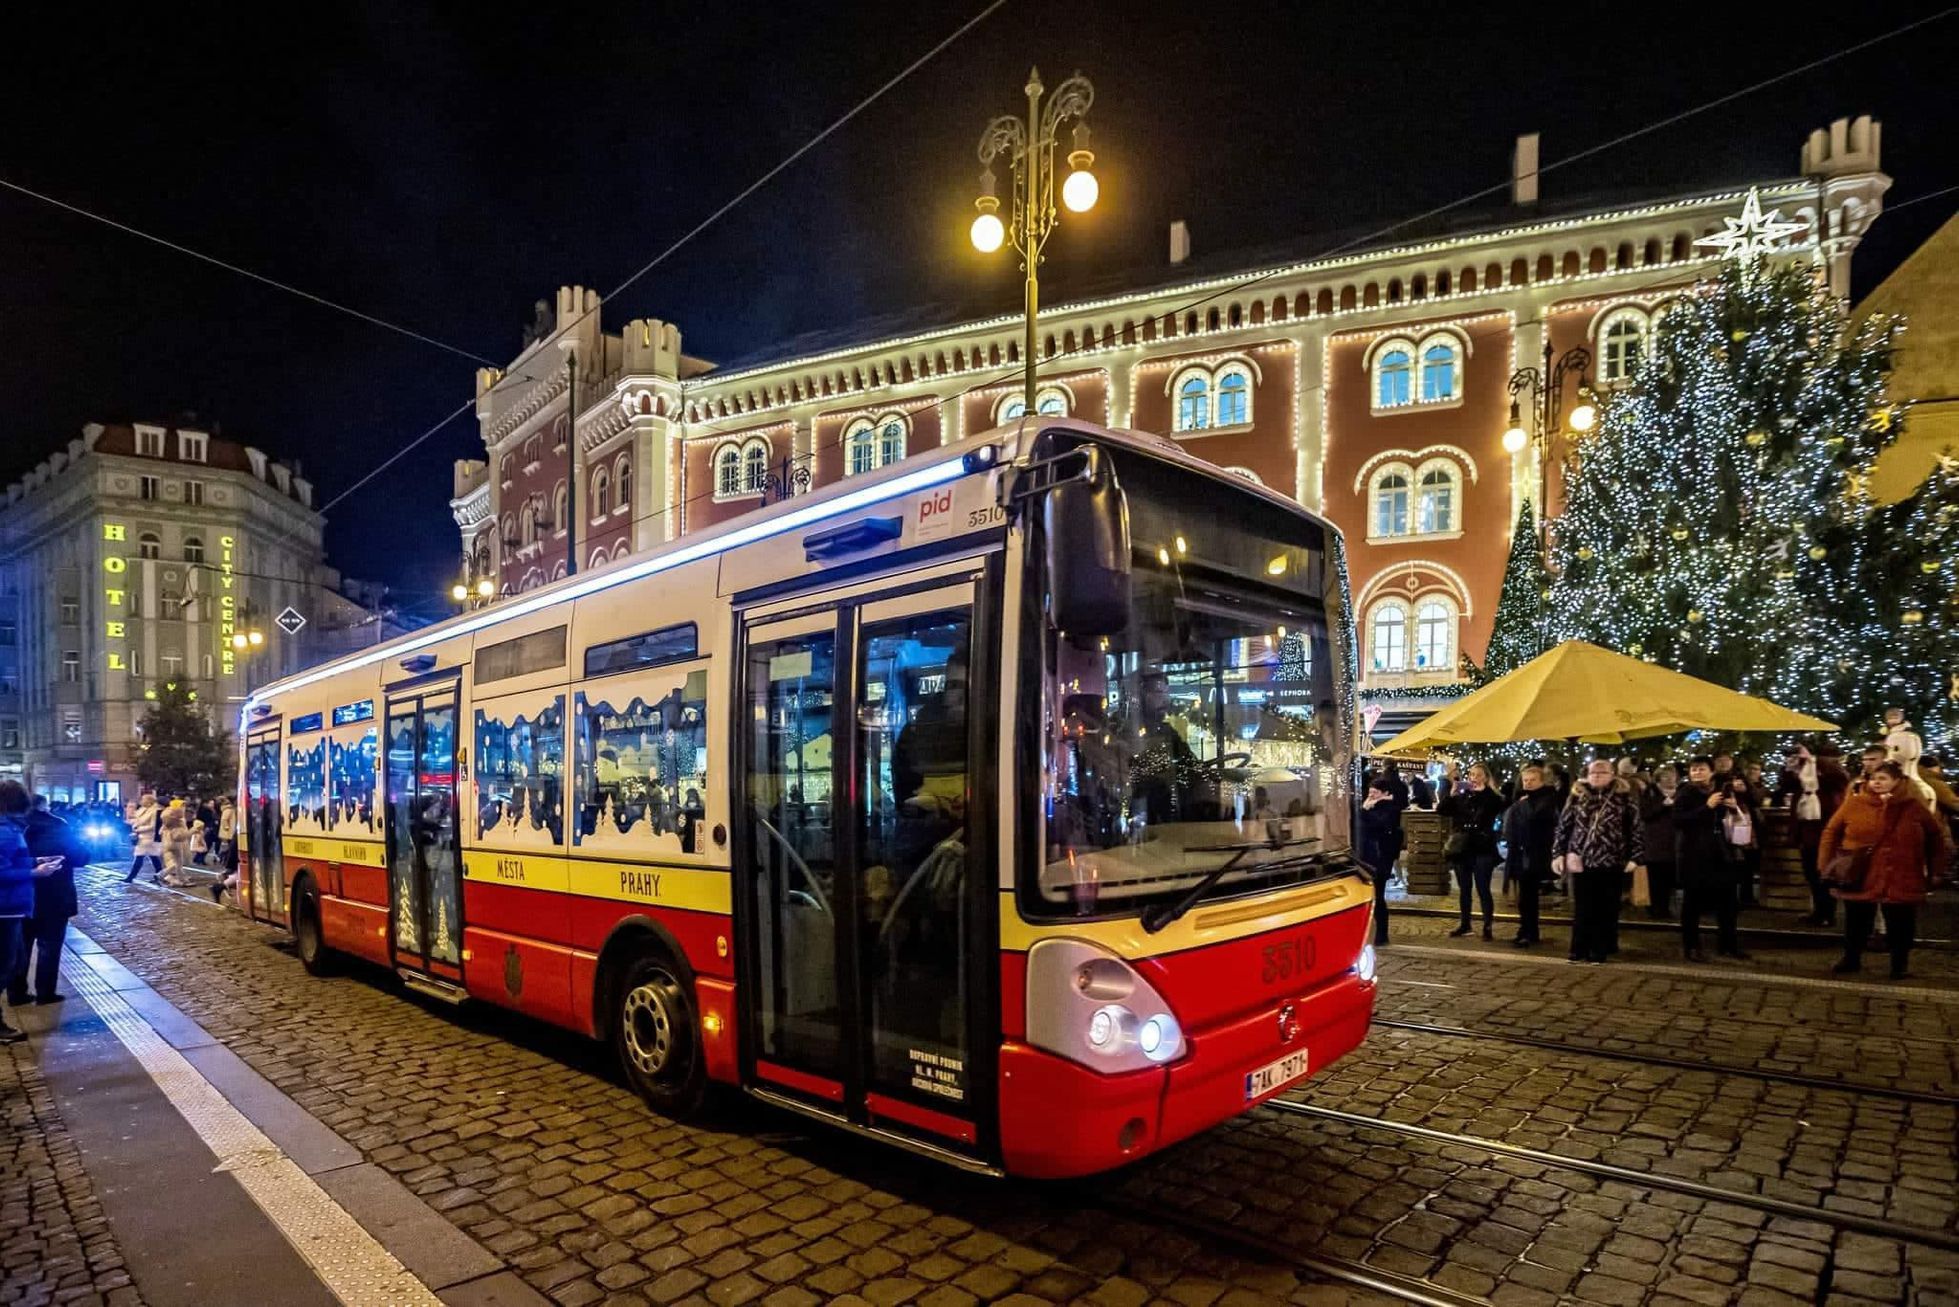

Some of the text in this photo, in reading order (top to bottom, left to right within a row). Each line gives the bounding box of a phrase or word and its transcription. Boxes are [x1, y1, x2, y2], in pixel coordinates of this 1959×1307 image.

[920, 489, 952, 523] pid
[104, 524, 126, 670] HOTEL
[221, 536, 235, 675] CITY CENTRE
[496, 858, 525, 881] MĚSTA
[1254, 1053, 1304, 1096] 7AK 7971
